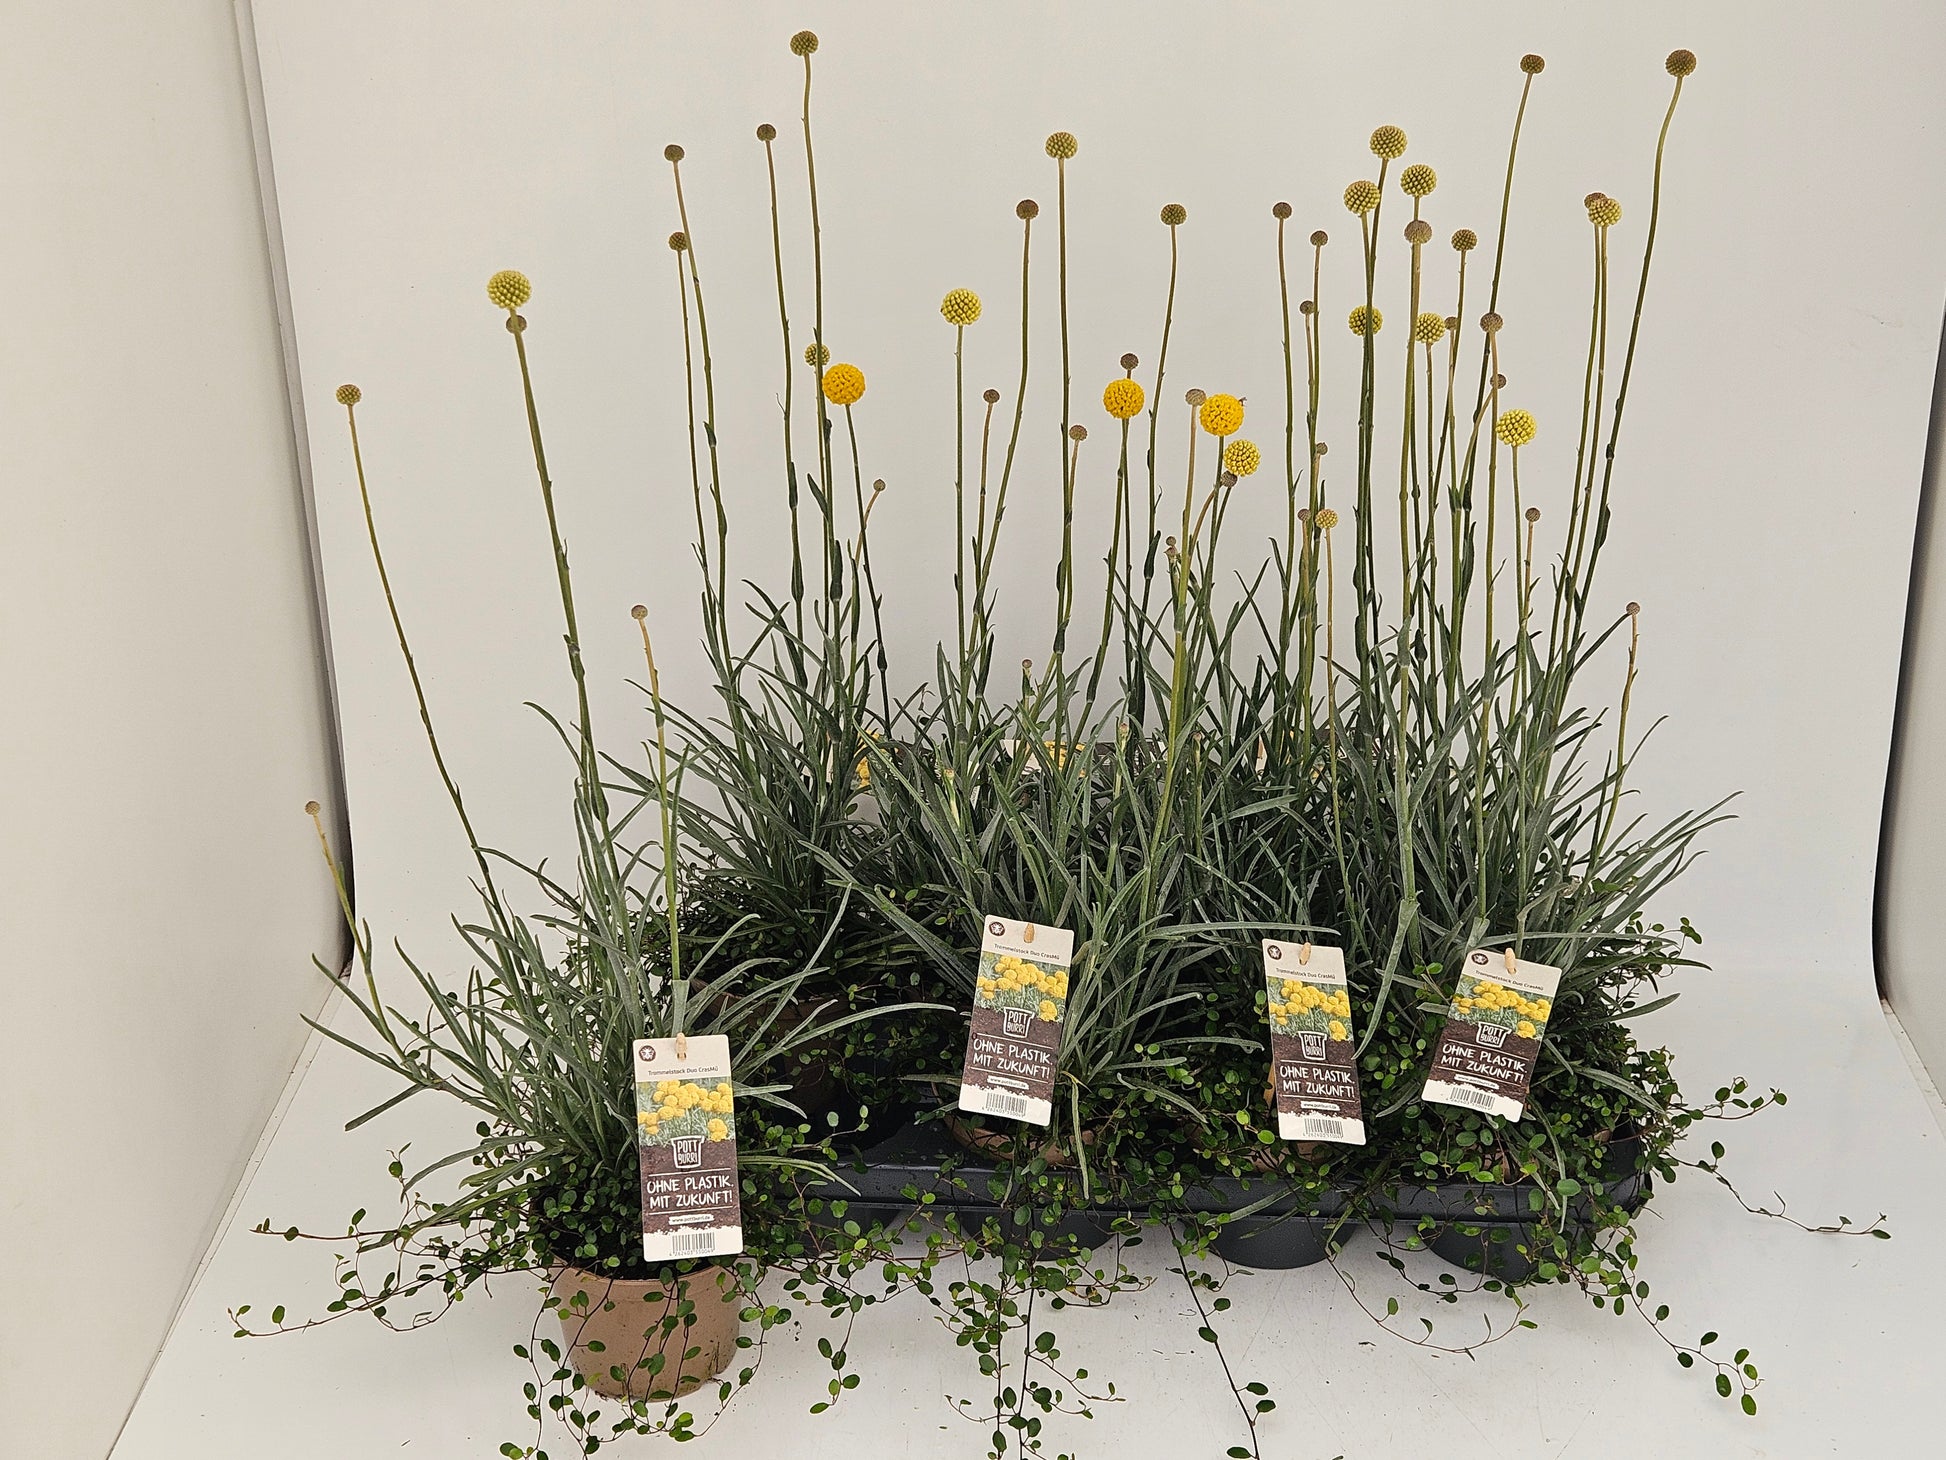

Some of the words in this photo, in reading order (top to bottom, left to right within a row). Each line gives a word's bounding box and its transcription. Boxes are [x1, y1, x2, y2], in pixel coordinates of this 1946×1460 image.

[994, 944, 1028, 954] Trommelstock
[1276, 968, 1306, 976] Trommelstock
[1476, 970, 1511, 984] Trommelstock
[1008, 1011, 1028, 1024] POTT
[1007, 1022, 1025, 1034] BURRI
[1482, 1026, 1503, 1037] POTT
[1304, 1034, 1321, 1046] POTT
[1480, 1034, 1500, 1044] BURRI
[973, 1039, 1005, 1054] OHNE
[1009, 1045, 1052, 1065] PLASTIK.
[1306, 1046, 1322, 1056] BURRI
[1442, 1044, 1476, 1058] OHNE
[1480, 1051, 1527, 1073] PLASTIK.
[973, 1053, 994, 1066] MIT
[997, 1058, 1050, 1079] ZUKUNFT!
[1441, 1056, 1462, 1067] MIT
[1466, 1061, 1524, 1083] ZUKUNFT!
[1280, 1066, 1309, 1078] OHNE
[1313, 1068, 1355, 1084] PLASTIK.
[1283, 1080, 1301, 1092] MIT
[1307, 1082, 1355, 1098] ZUKUNFT!
[678, 1140, 697, 1152] POTT
[678, 1152, 697, 1164] BURRI
[647, 1179, 680, 1194] OHNE
[685, 1175, 734, 1190] PLASTIK.
[650, 1196, 670, 1209] MIT
[676, 1190, 732, 1206] ZUKUNFT!
